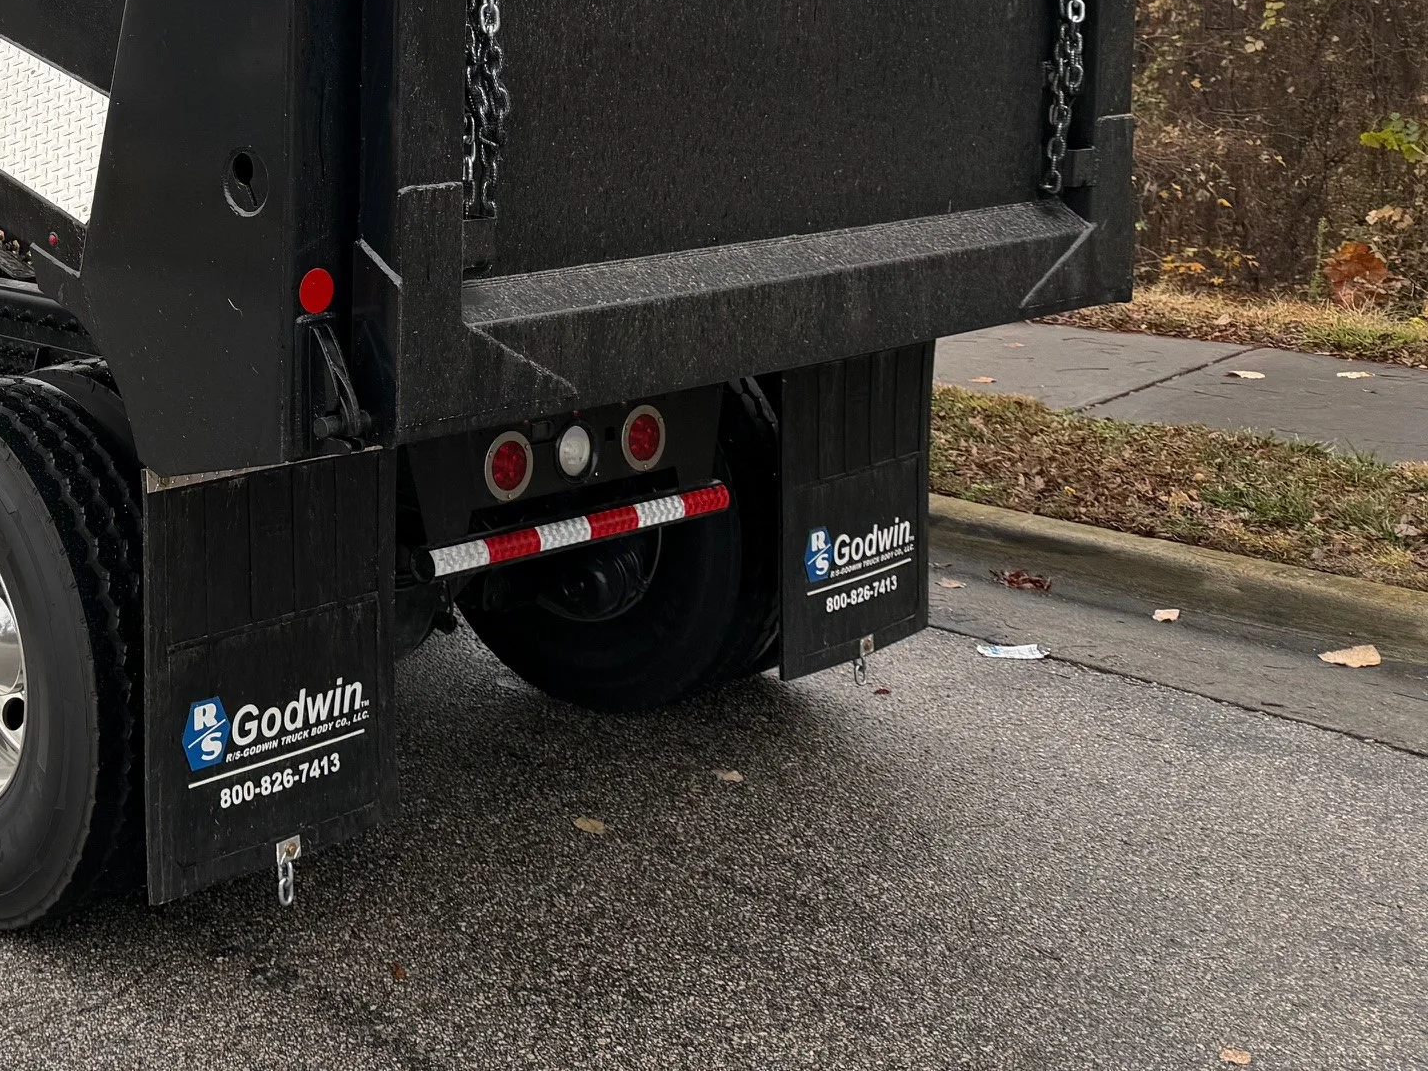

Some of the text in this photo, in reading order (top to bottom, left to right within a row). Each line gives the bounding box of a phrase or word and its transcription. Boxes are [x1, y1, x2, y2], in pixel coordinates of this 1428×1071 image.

[833, 517, 911, 566] Godwin
[826, 575, 897, 613] 800-826-7413
[225, 739, 279, 763] R/S-GODWIN
[280, 729, 310, 746] TRUCK
[311, 721, 334, 737] BODY
[352, 711, 370, 723] LLC.
[232, 677, 363, 746] Godwin
[220, 752, 341, 809] 800-826-7413
